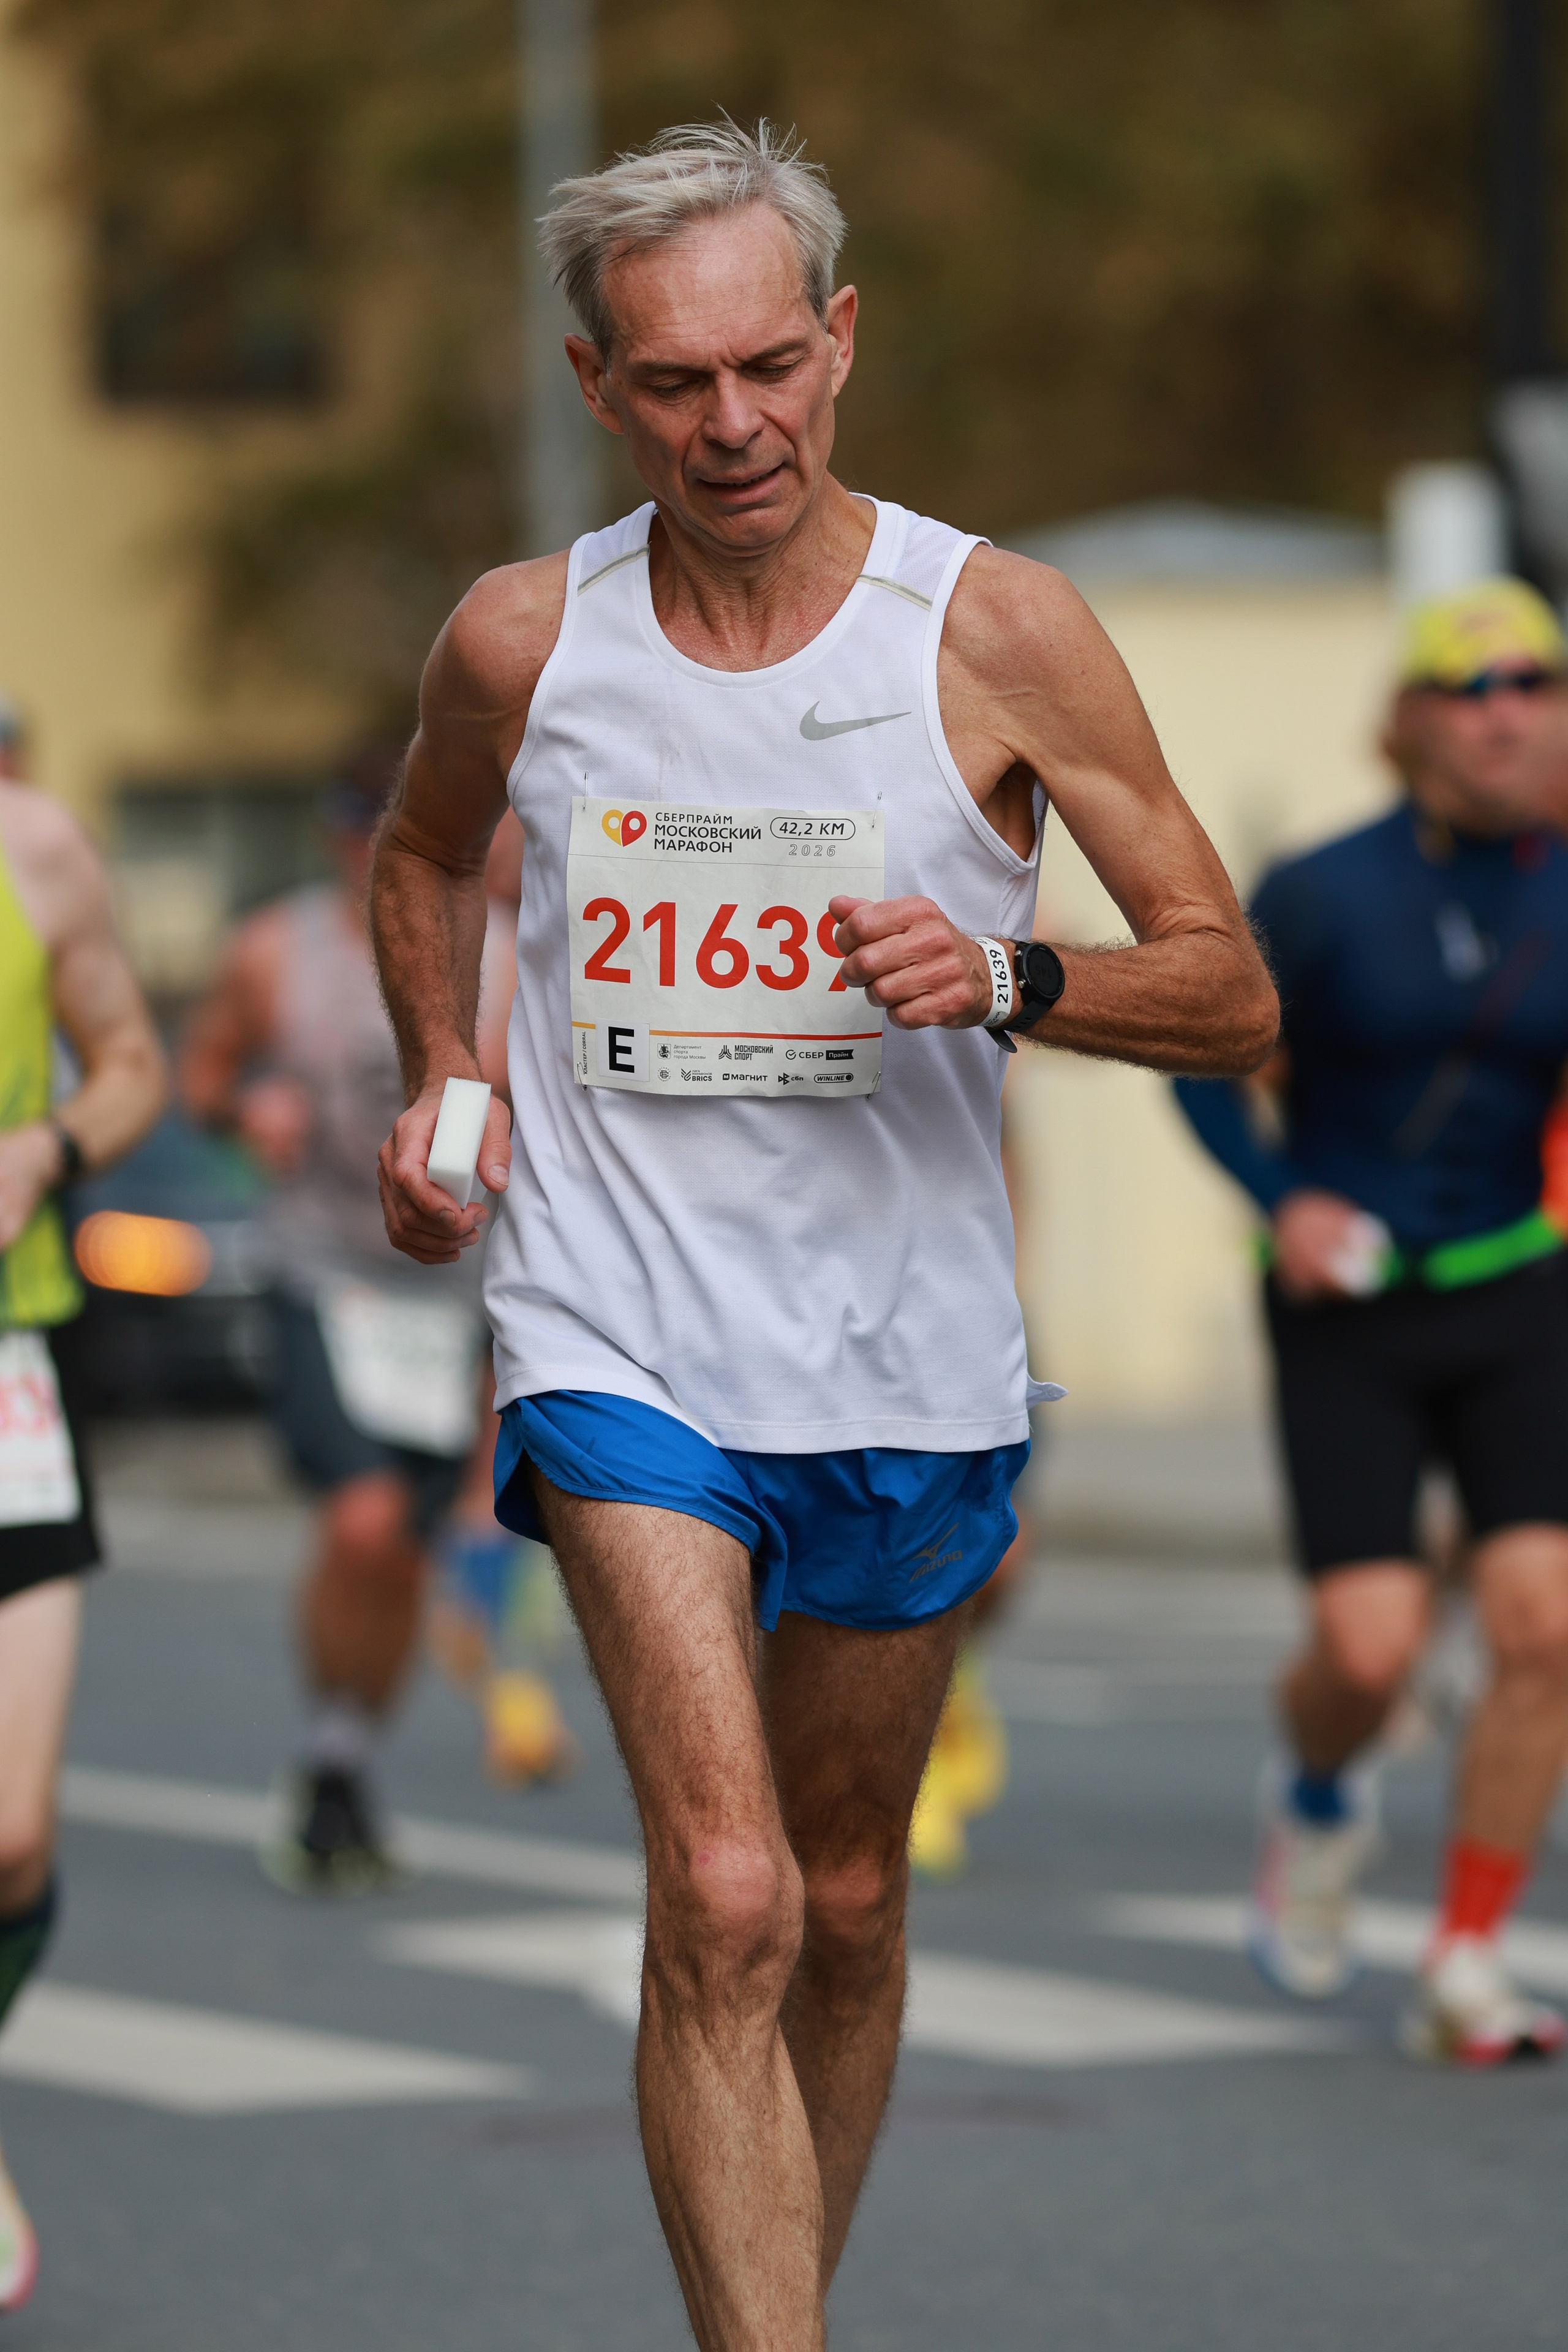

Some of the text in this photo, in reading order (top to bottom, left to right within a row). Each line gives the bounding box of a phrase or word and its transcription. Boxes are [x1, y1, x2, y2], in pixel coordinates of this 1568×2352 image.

[655, 812, 733, 825] СБЕРПРАЙМ
[654, 824, 762, 840] МОСКОВСКИЙ
[779, 822, 845, 837] 42,2 КМ
[654, 839, 733, 853] МАРАФОН
[788, 843, 837, 857] 2026
[989, 949, 1009, 1004] 21639
[608, 1027, 635, 1073] E
[734, 1044, 774, 1054] МОСКОВСКИЙ
